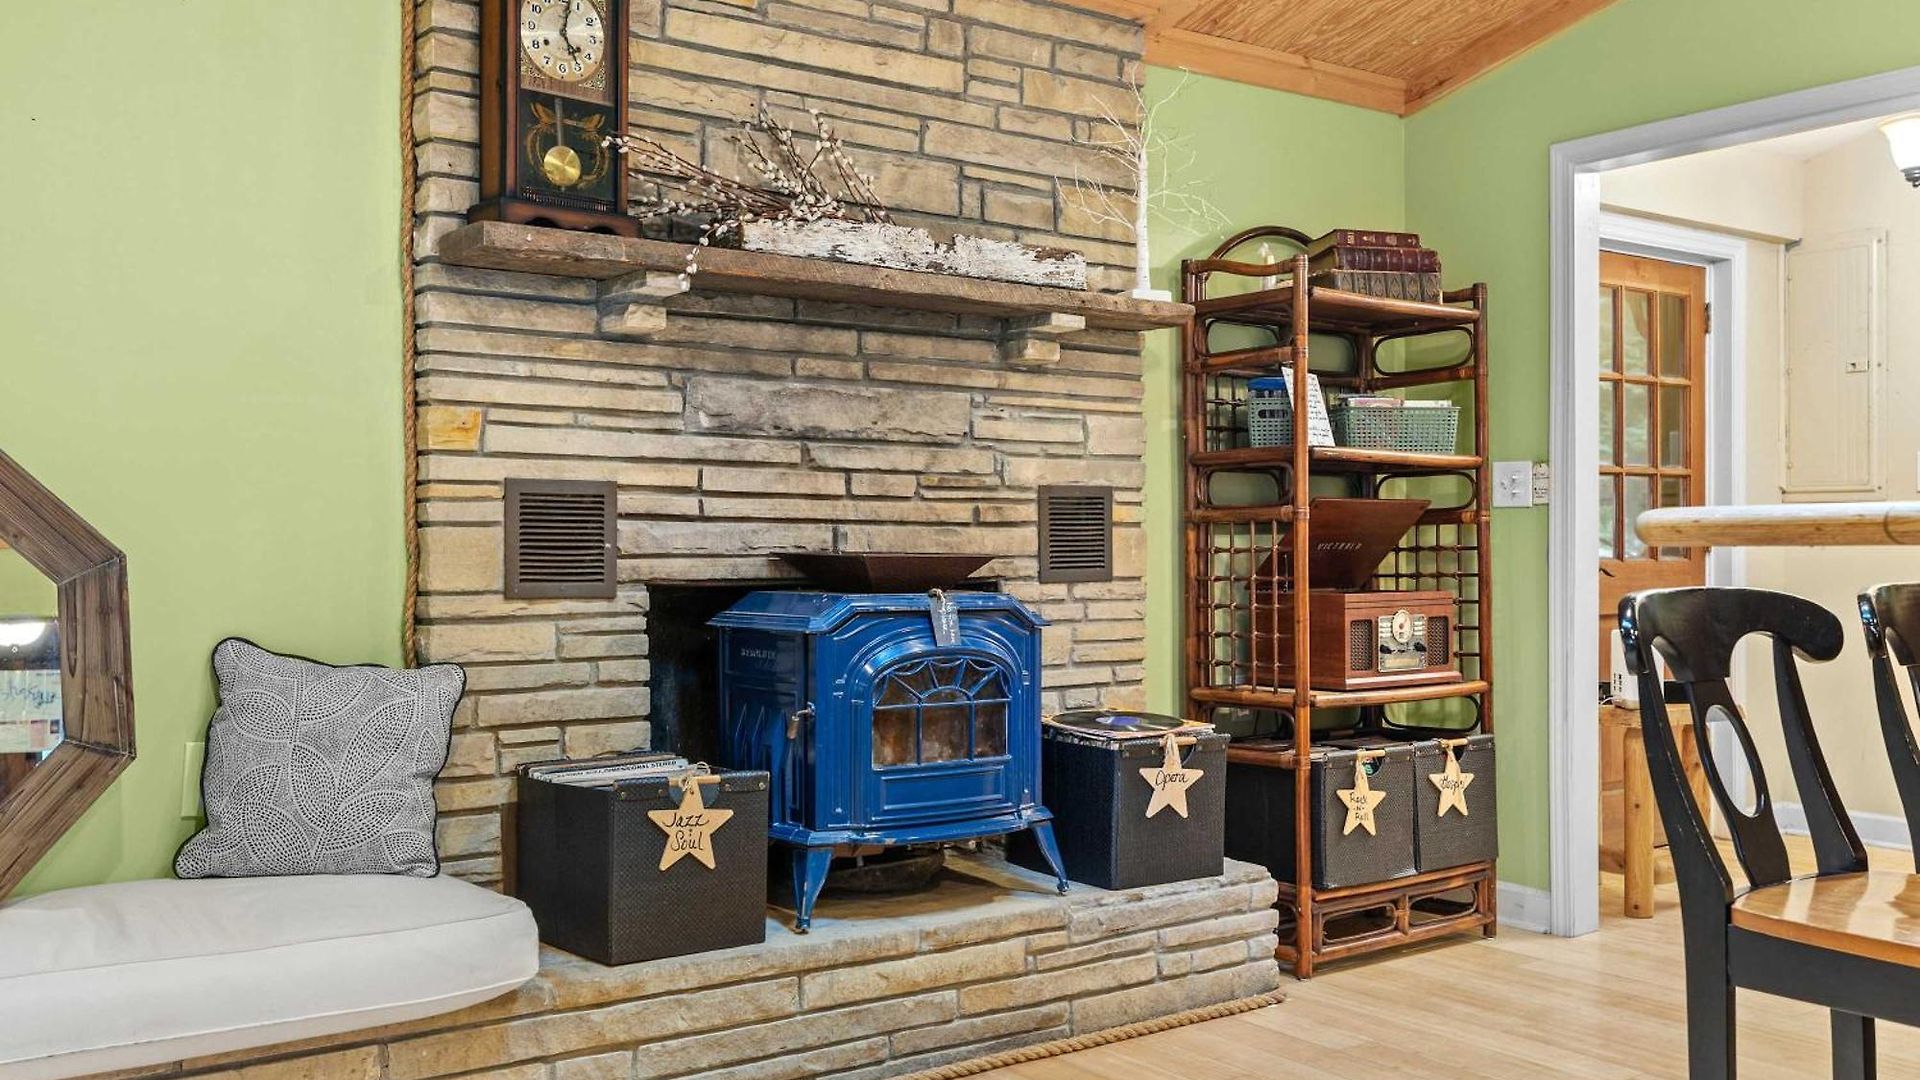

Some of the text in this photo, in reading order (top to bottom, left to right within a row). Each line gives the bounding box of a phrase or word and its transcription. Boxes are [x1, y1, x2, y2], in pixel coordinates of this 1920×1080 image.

[531, 4, 541, 14] 10
[528, 20, 536, 30] 9
[532, 40, 540, 49] 8
[543, 55, 551, 65] 7
[584, 53, 592, 61] 4
[558, 63, 567, 73] 6
[1156, 770, 1189, 791] Opera
[662, 812, 710, 828] Jazz
[671, 830, 704, 852] Soul
